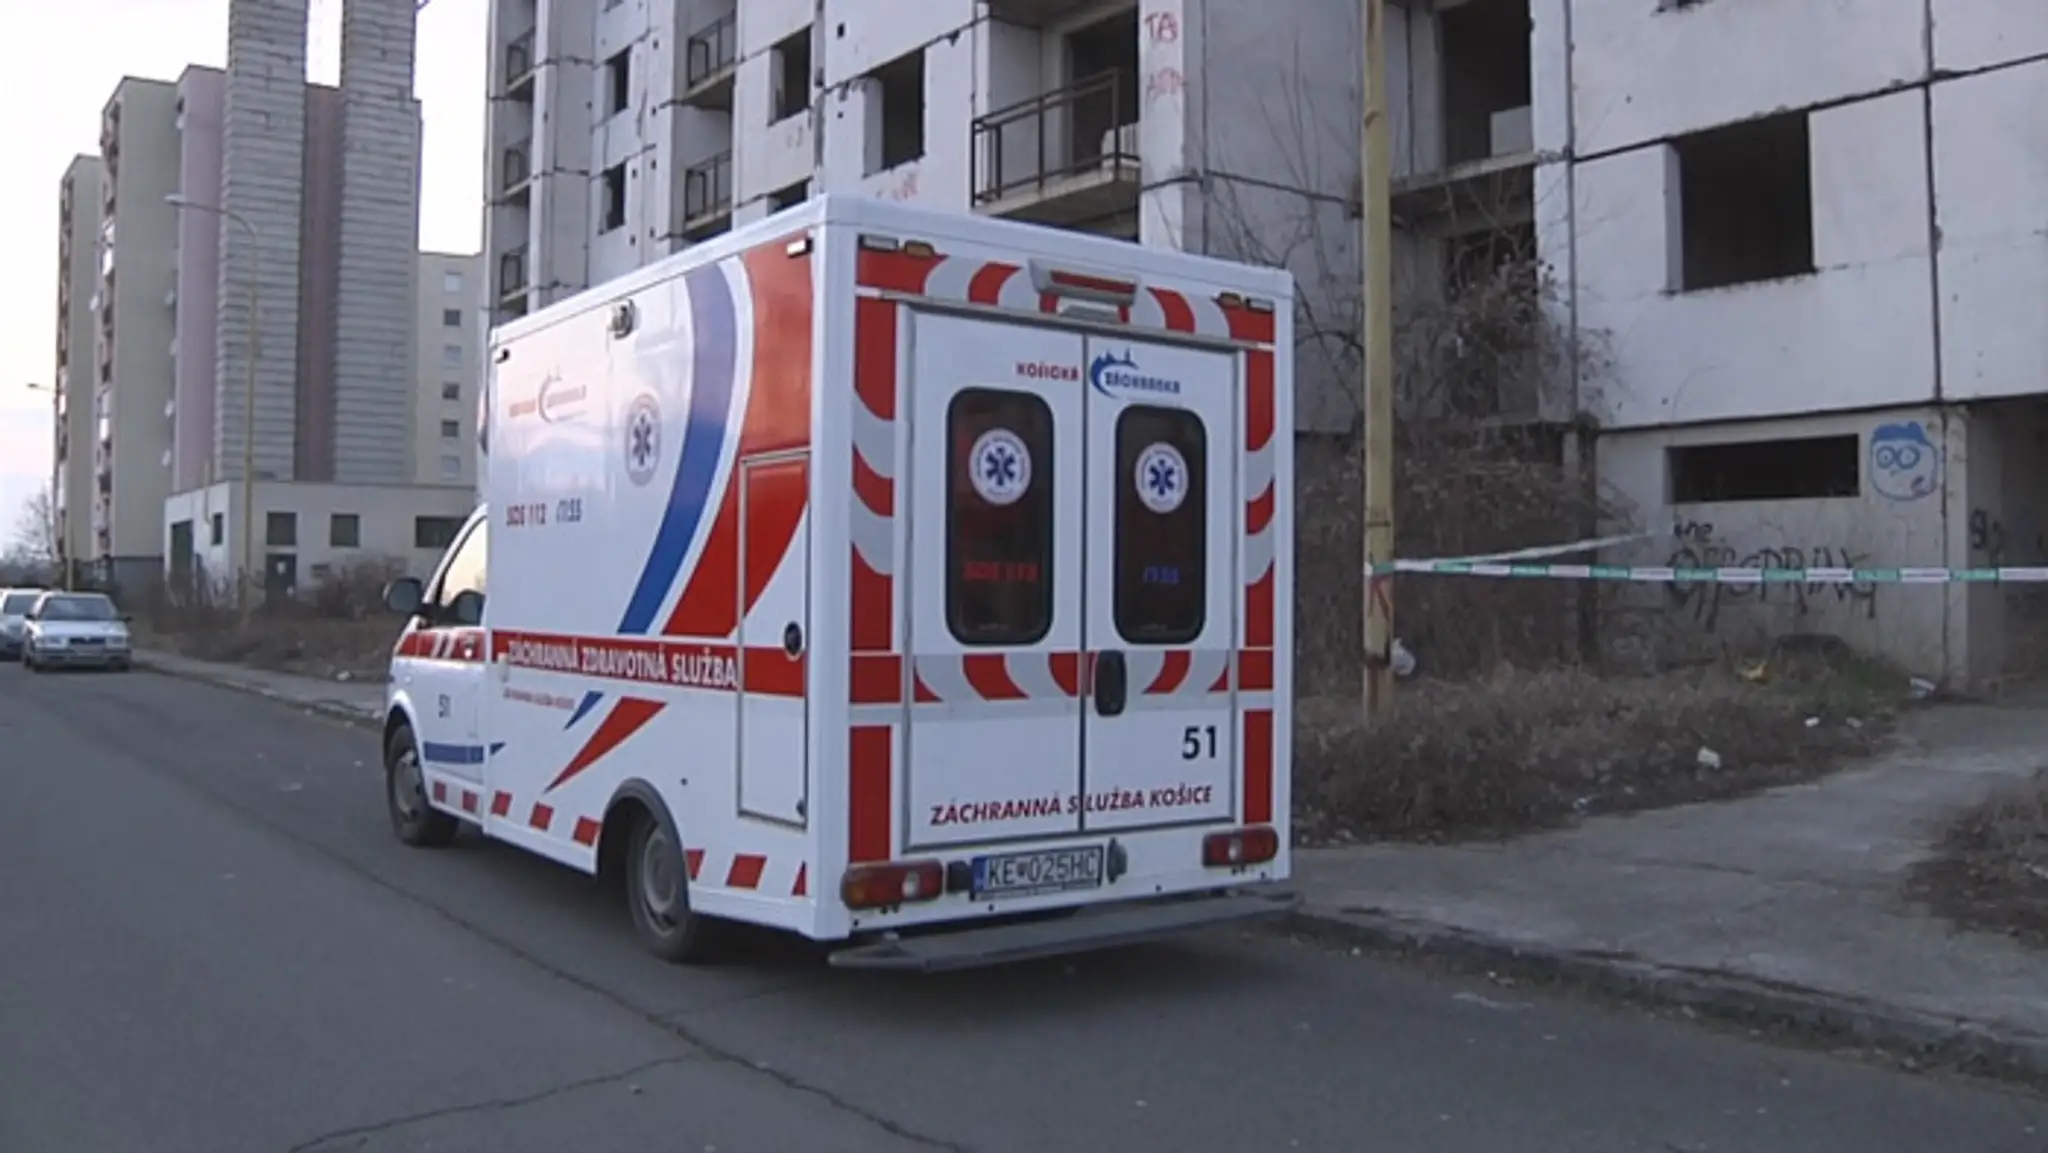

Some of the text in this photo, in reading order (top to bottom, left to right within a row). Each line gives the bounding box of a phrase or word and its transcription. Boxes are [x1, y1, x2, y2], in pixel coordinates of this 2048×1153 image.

[580, 643, 668, 681] ZDRAVOTNÁ
[671, 647, 741, 690] SLUŽBA
[1182, 725, 1217, 760] 51
[929, 790, 1062, 827] ZÁCHRANNÁ
[1149, 780, 1214, 808] KOŠICE
